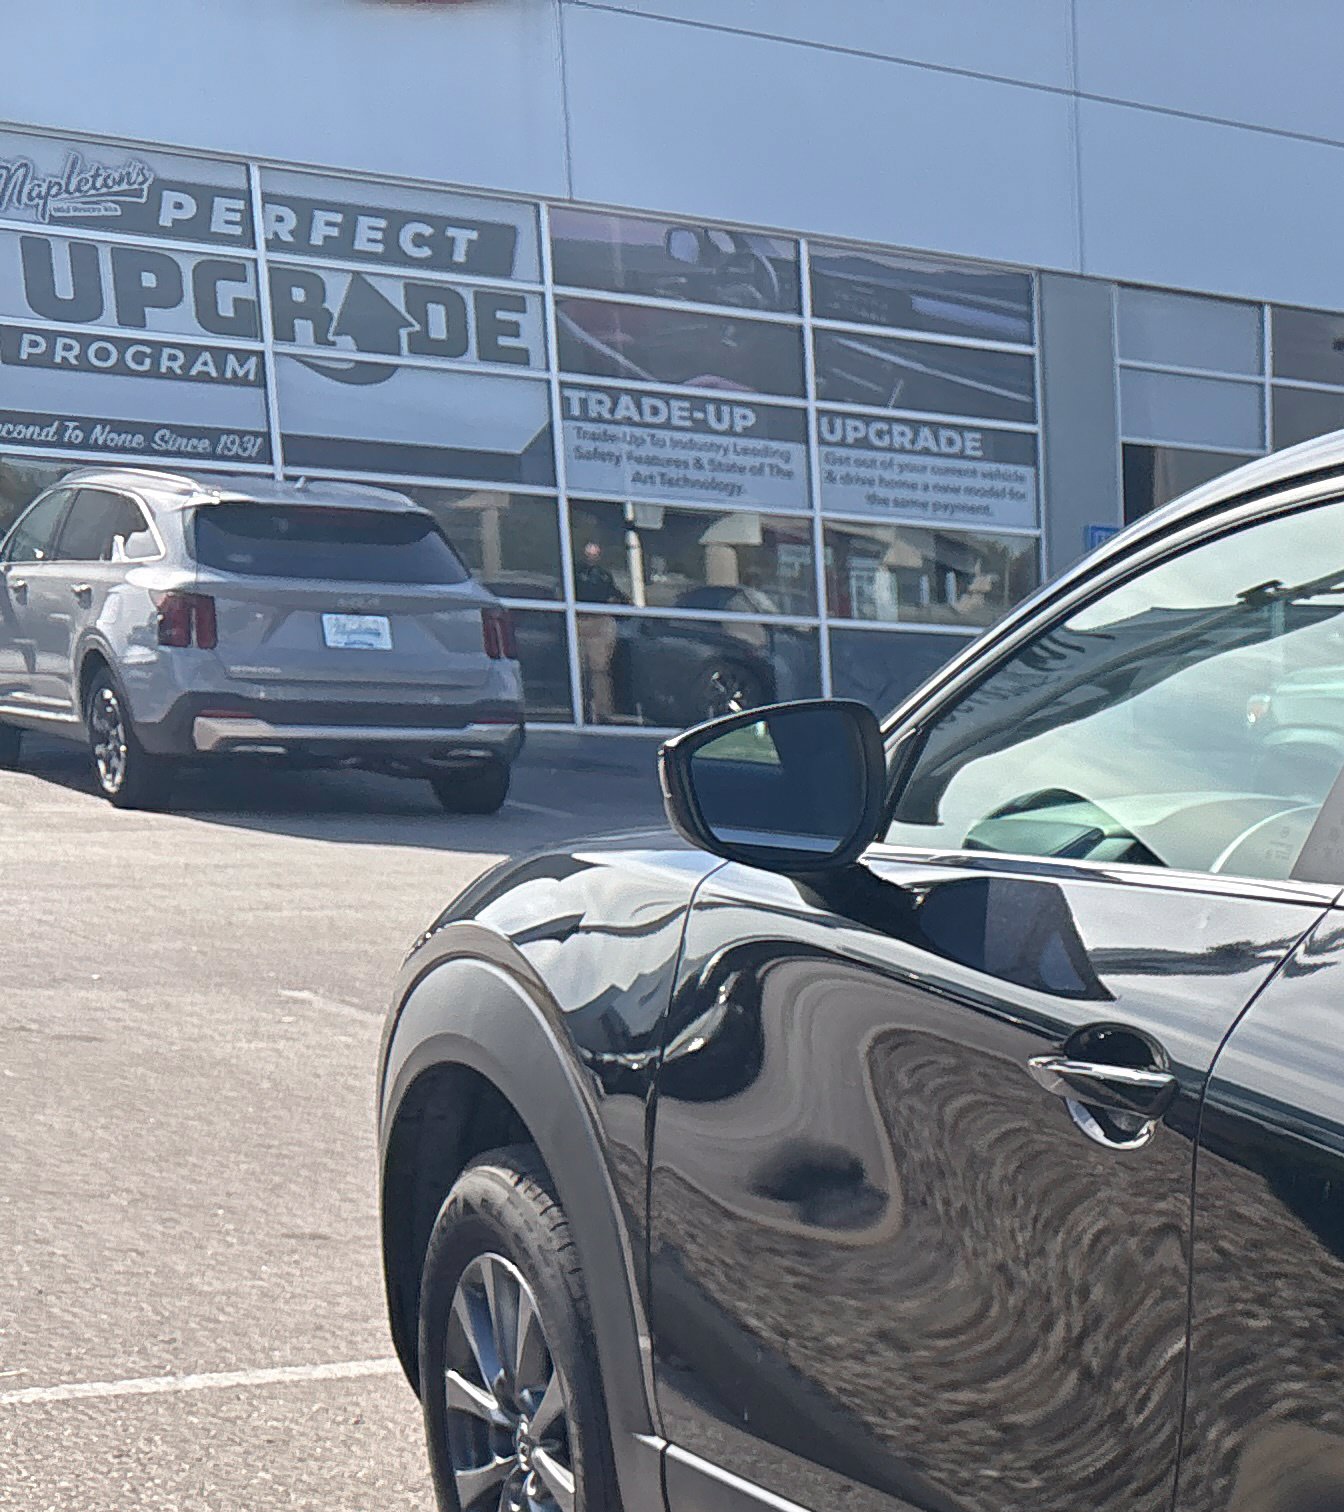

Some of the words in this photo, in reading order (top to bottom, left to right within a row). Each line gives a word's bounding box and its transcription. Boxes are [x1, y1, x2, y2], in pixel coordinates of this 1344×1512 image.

[158, 189, 479, 264] PERFECT
[20, 235, 531, 367] UPGRADE
[20, 332, 259, 382] PROGRAM
[562, 388, 757, 434] TRADE-UP
[62, 421, 85, 444] To
[88, 424, 147, 449] None
[150, 428, 213, 453] Since
[215, 433, 264, 458] 1931
[819, 415, 984, 458] UPGRADE
